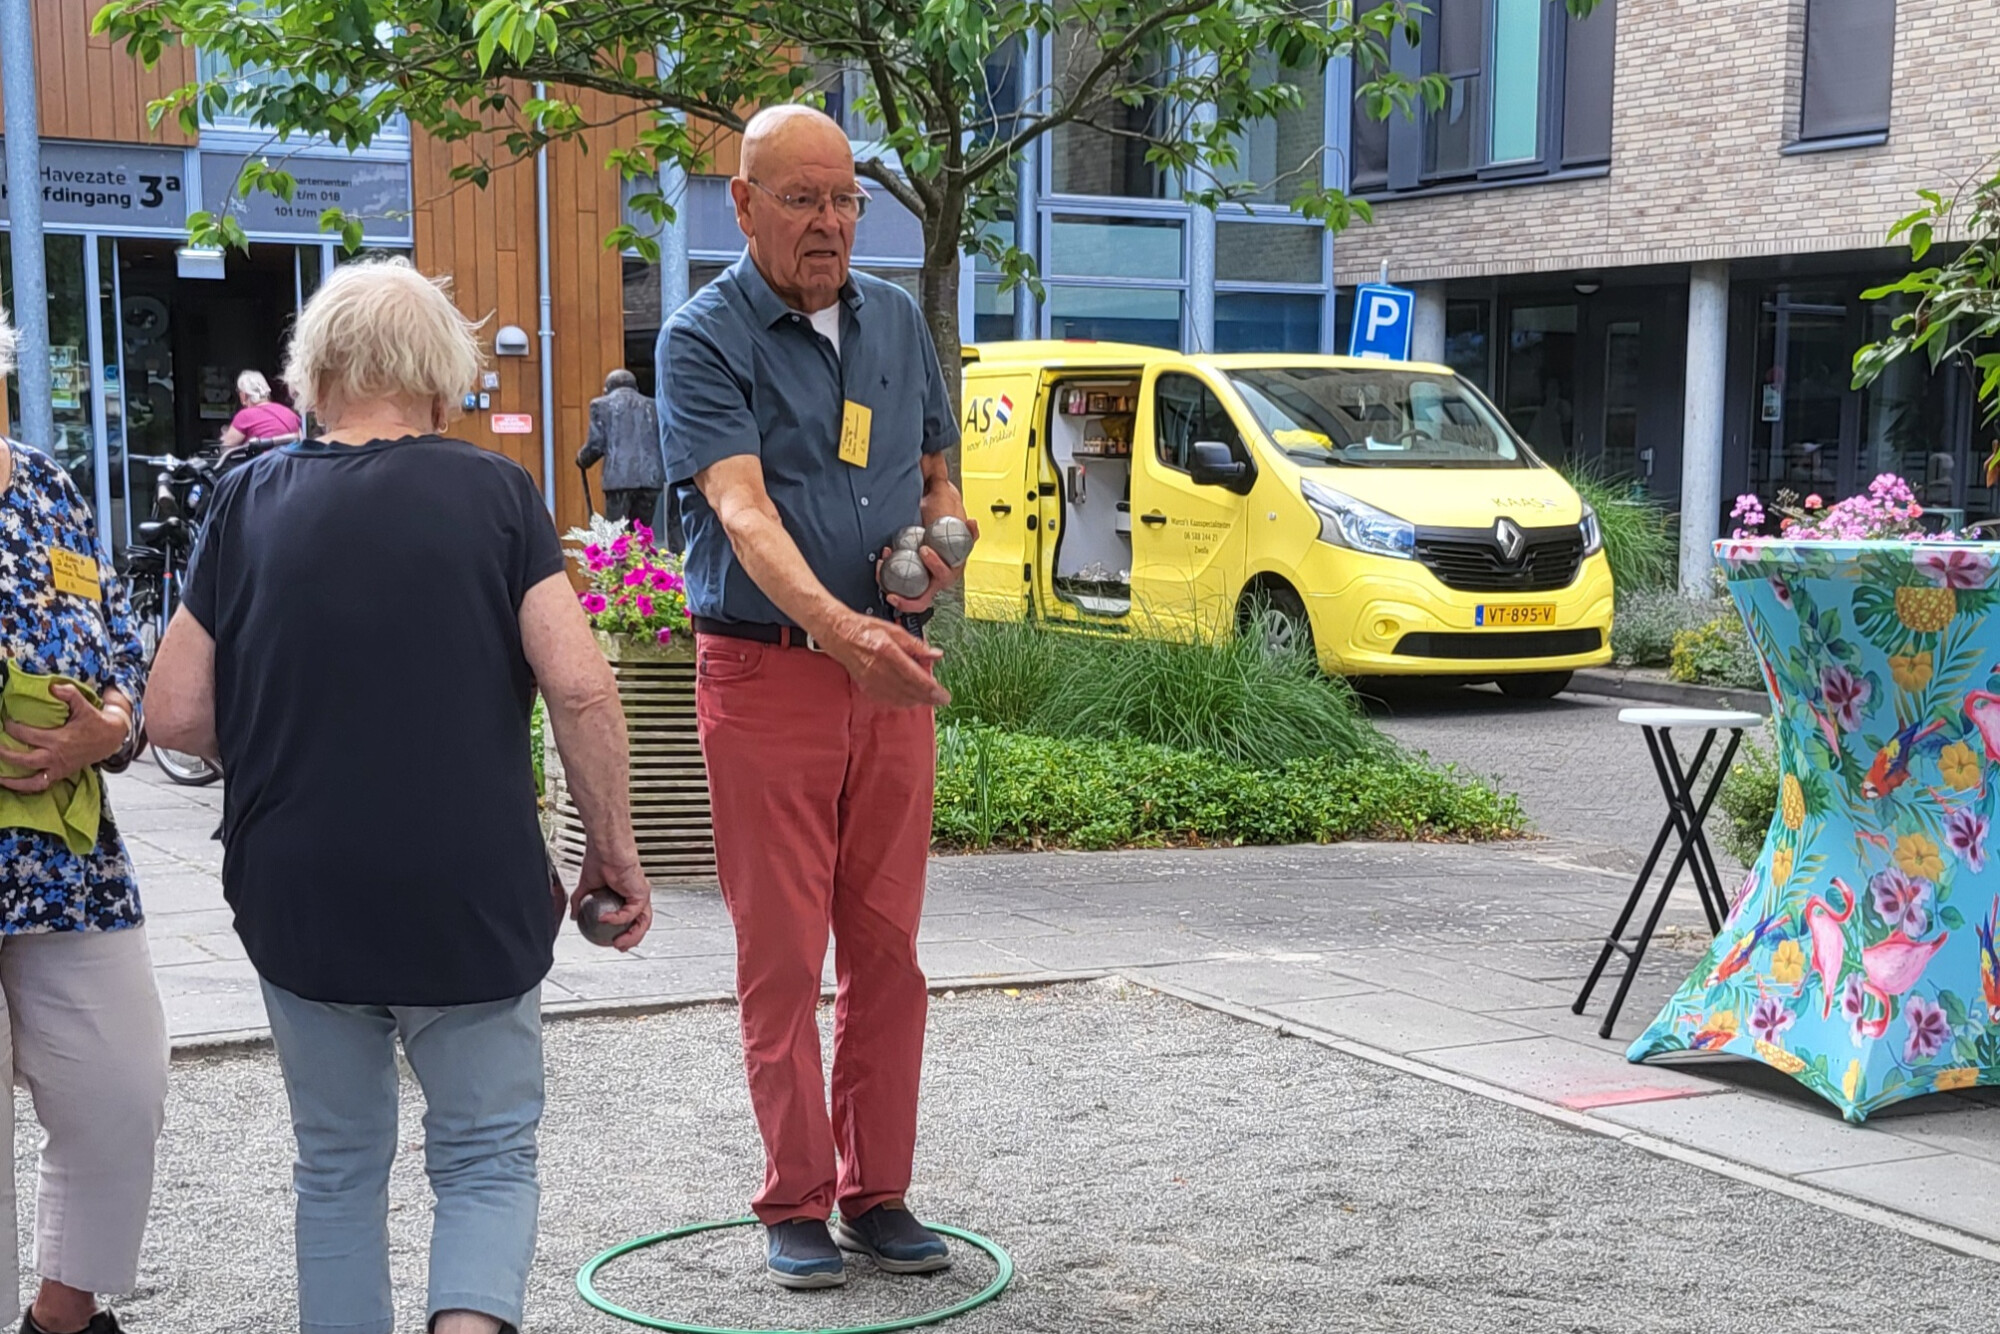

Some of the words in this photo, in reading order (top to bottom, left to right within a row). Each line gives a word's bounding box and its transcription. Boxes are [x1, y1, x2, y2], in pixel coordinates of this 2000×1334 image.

[40, 166, 126, 185] Havezate
[2, 184, 131, 209] Hfdingang
[296, 190, 318, 201] t/m
[320, 191, 341, 202] 018
[274, 206, 293, 217] 101
[296, 207, 318, 218] t/m
[1366, 296, 1399, 341] P
[1491, 498, 1545, 508] KAAS
[1184, 531, 1190, 540] 06
[1489, 607, 1552, 623] VT-895-V
